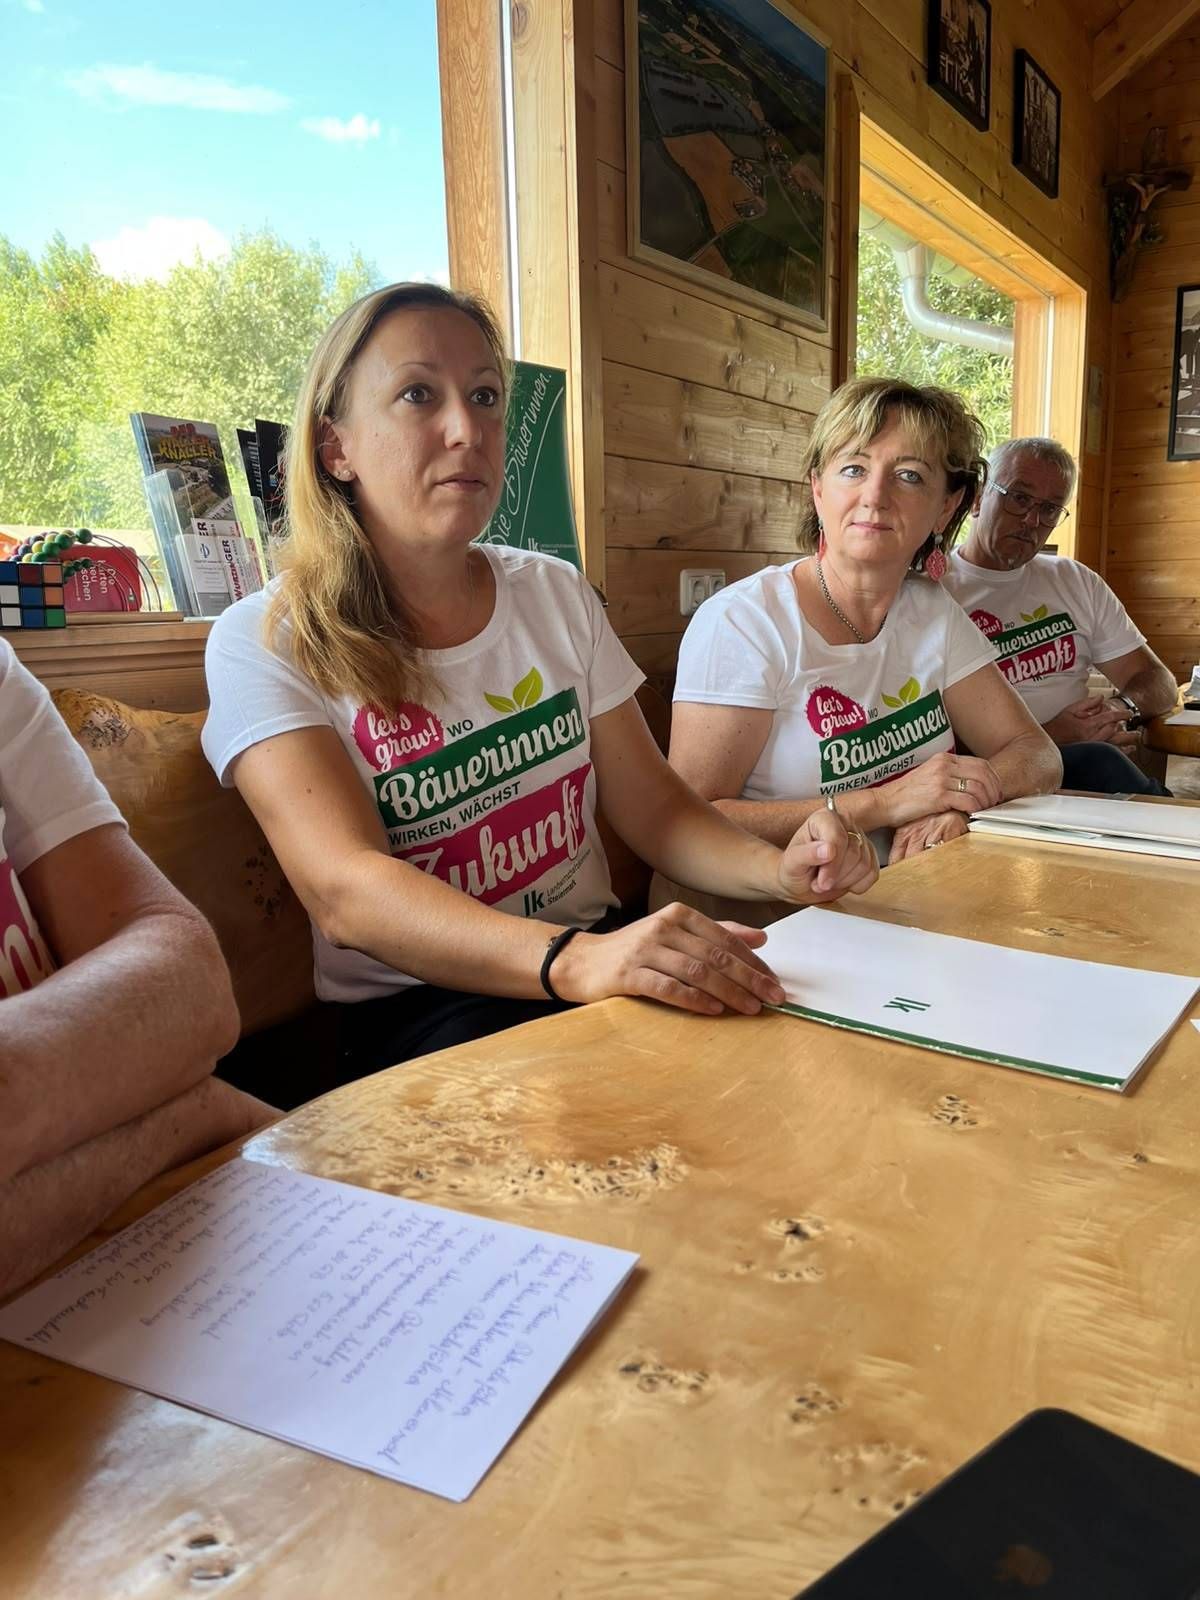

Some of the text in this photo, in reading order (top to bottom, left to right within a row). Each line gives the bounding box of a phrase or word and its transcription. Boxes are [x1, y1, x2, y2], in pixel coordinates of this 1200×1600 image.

[993, 618, 1073, 657] uerinnen
[1003, 638, 1074, 683] ukunft
[816, 695, 844, 716] let's
[820, 705, 864, 739] grow!
[375, 717, 441, 773] grow!
[446, 718, 475, 739] WO
[823, 704, 947, 776] Bäuerinnen
[379, 707, 583, 821] Bäuerinnen
[820, 754, 916, 796] WIRKEN, WÄCHST
[388, 780, 523, 847] WIRKEN, WÄCHST
[883, 996, 932, 1013] lk
